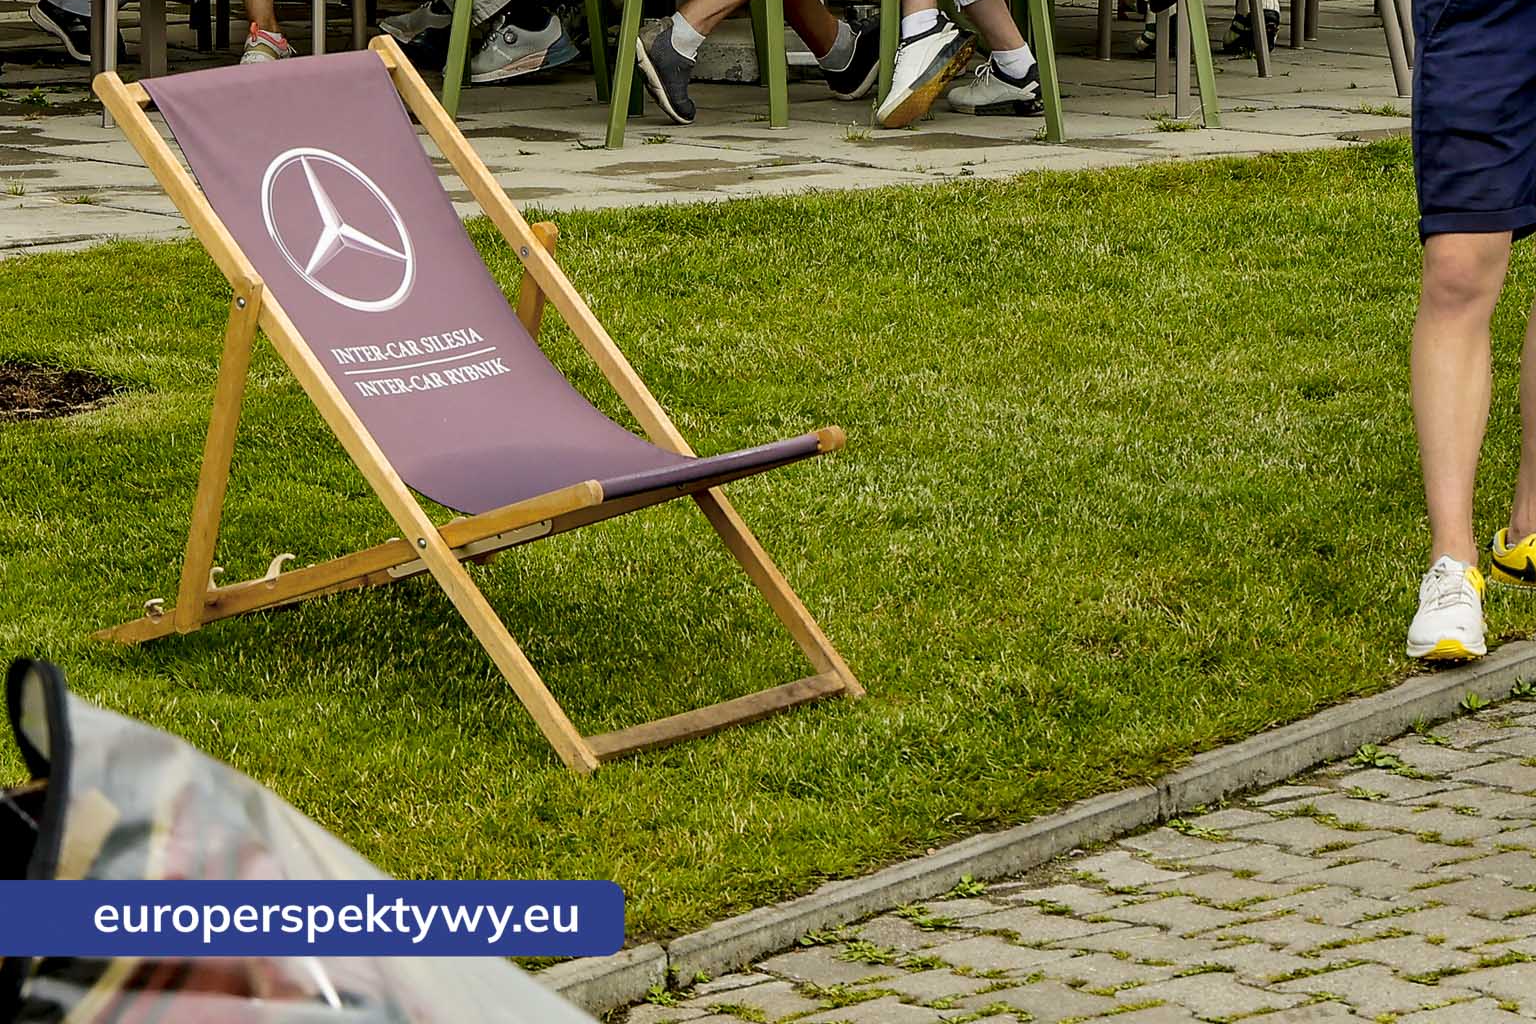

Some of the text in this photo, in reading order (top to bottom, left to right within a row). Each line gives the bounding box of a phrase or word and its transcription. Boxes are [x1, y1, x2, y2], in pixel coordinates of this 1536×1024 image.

[331, 327, 484, 365] INTER-CAR SILESIA
[354, 357, 511, 397] INTER-CAR RYBNIK
